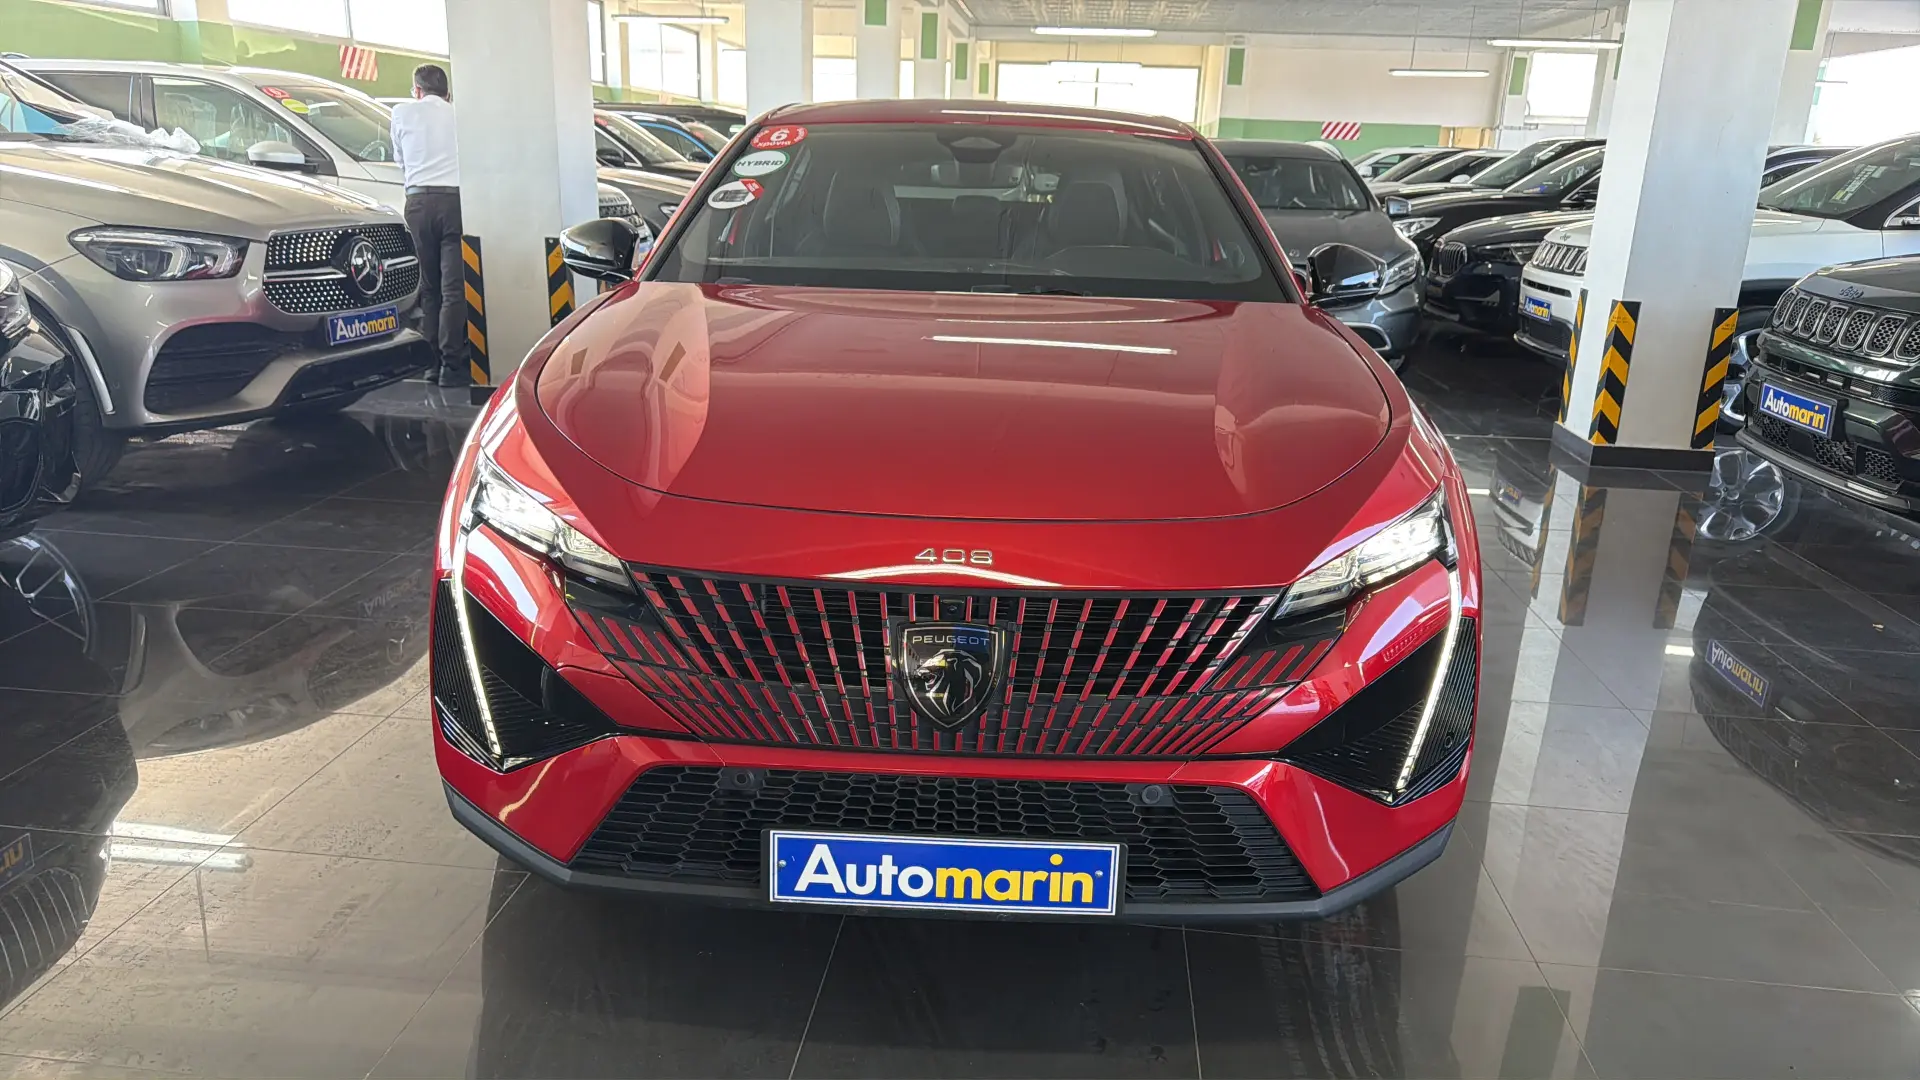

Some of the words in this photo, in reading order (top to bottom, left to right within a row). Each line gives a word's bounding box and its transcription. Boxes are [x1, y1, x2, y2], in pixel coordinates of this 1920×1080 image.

[770, 129, 790, 142] 6
[336, 310, 396, 340] Automarin
[1764, 388, 1826, 430] Automarin
[914, 548, 993, 565] 408
[912, 635, 990, 646] PEUGEOT
[794, 843, 1094, 903] Automarin
